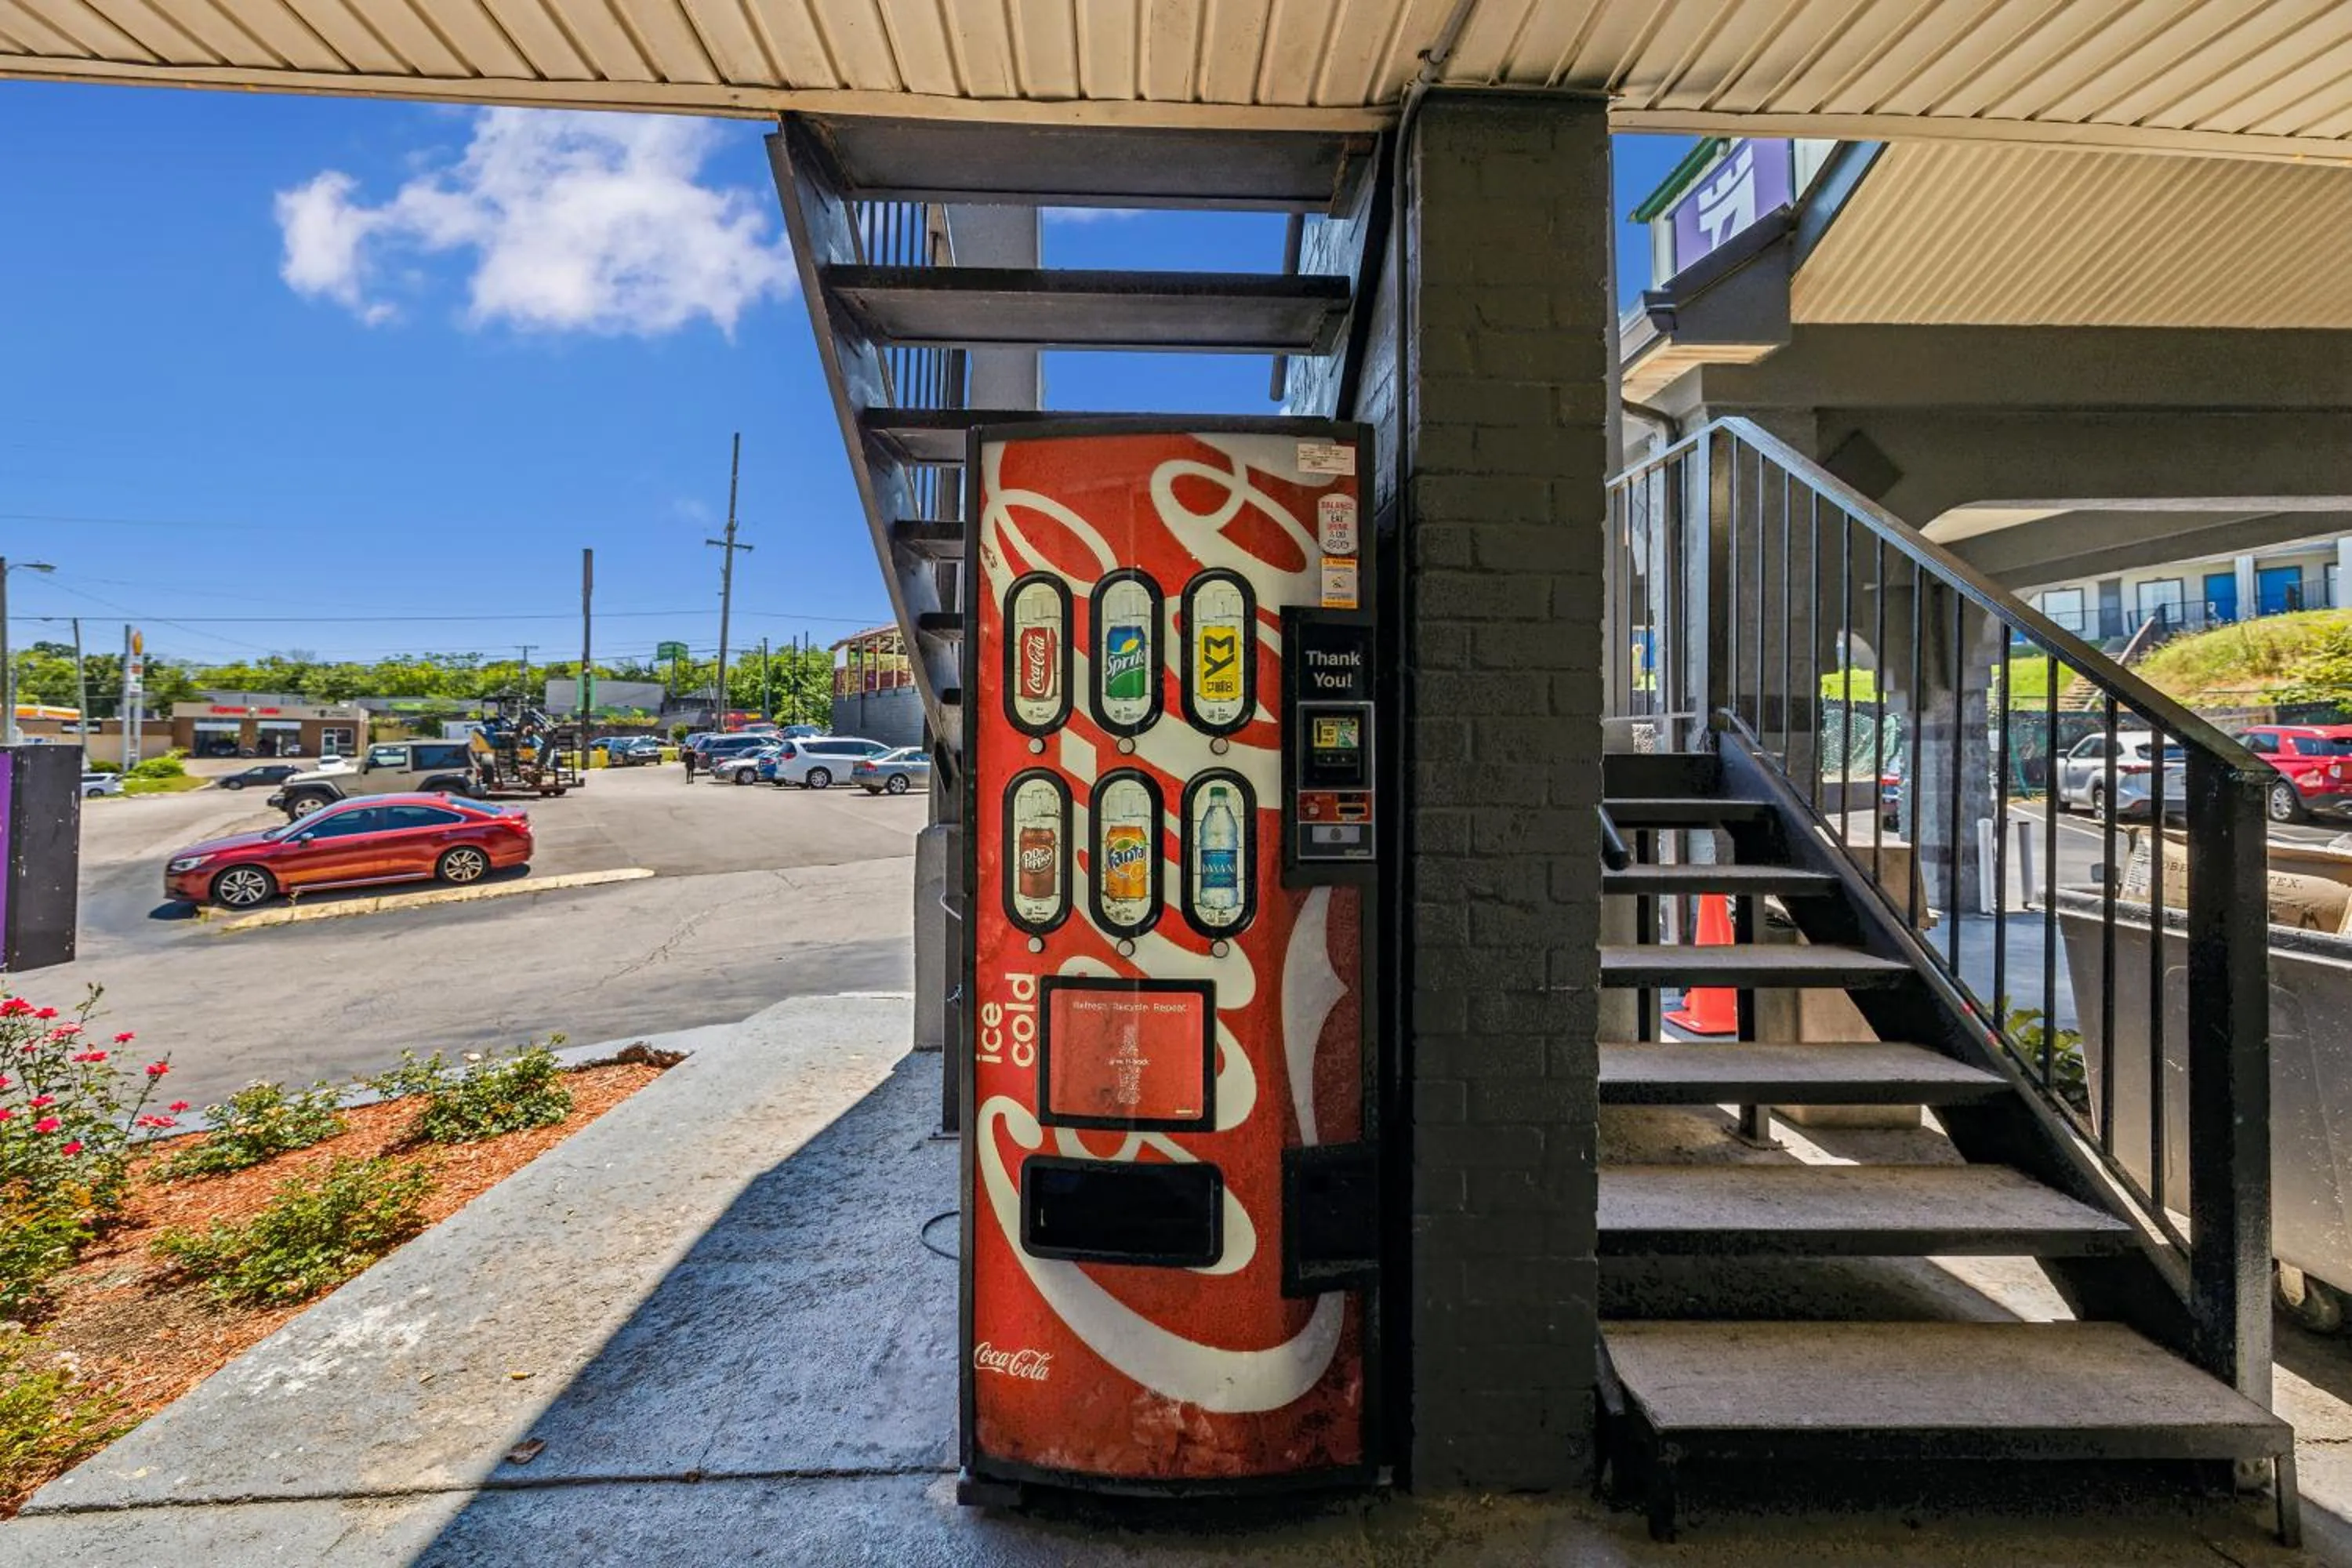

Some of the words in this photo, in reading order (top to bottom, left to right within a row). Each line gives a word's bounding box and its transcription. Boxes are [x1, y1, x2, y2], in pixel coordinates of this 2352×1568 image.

[1305, 650, 1361, 666] Thank
[1313, 671, 1353, 688] You!
[976, 1002, 1003, 1064] ice
[1004, 972, 1035, 1068] cold
[974, 1341, 1054, 1380] Coca-Cola
